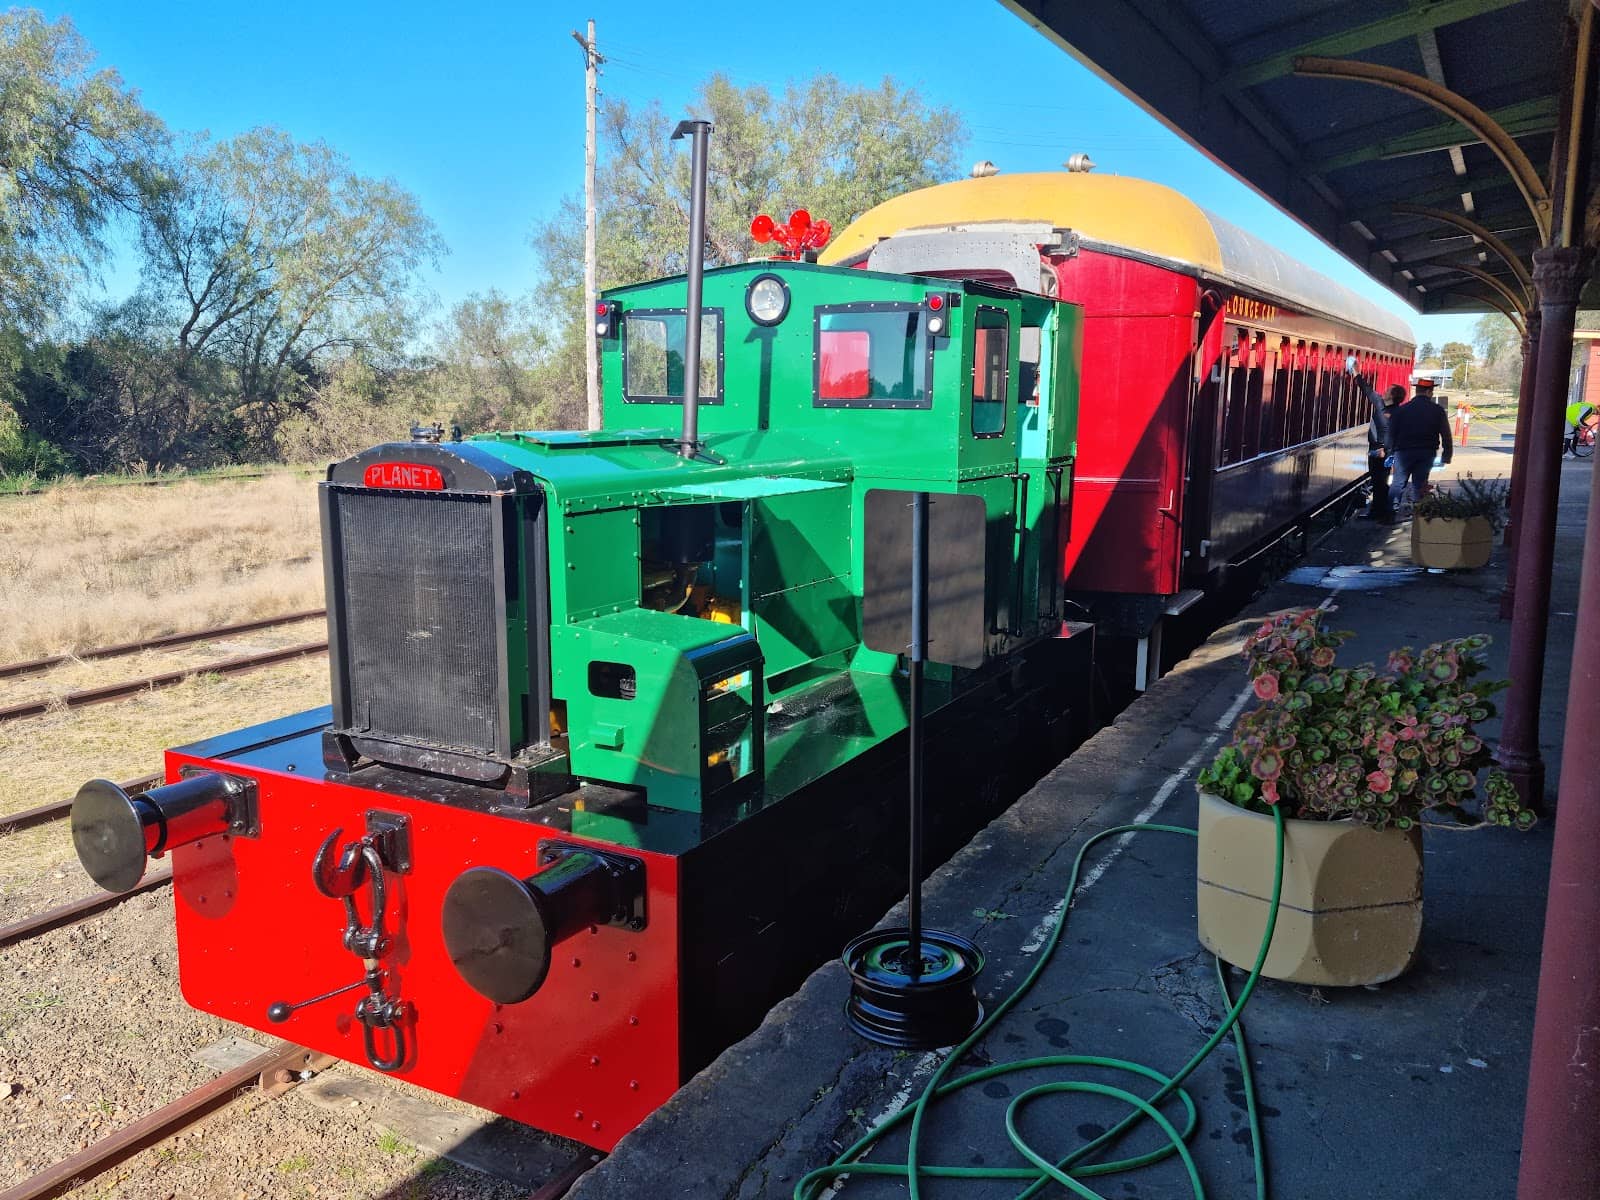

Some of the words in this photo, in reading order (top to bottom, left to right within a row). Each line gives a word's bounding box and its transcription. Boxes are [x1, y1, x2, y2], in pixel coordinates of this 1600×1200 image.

[1226, 295, 1259, 320] LOUNGE
[1262, 304, 1276, 322] CAR
[371, 465, 433, 487] PLANET
